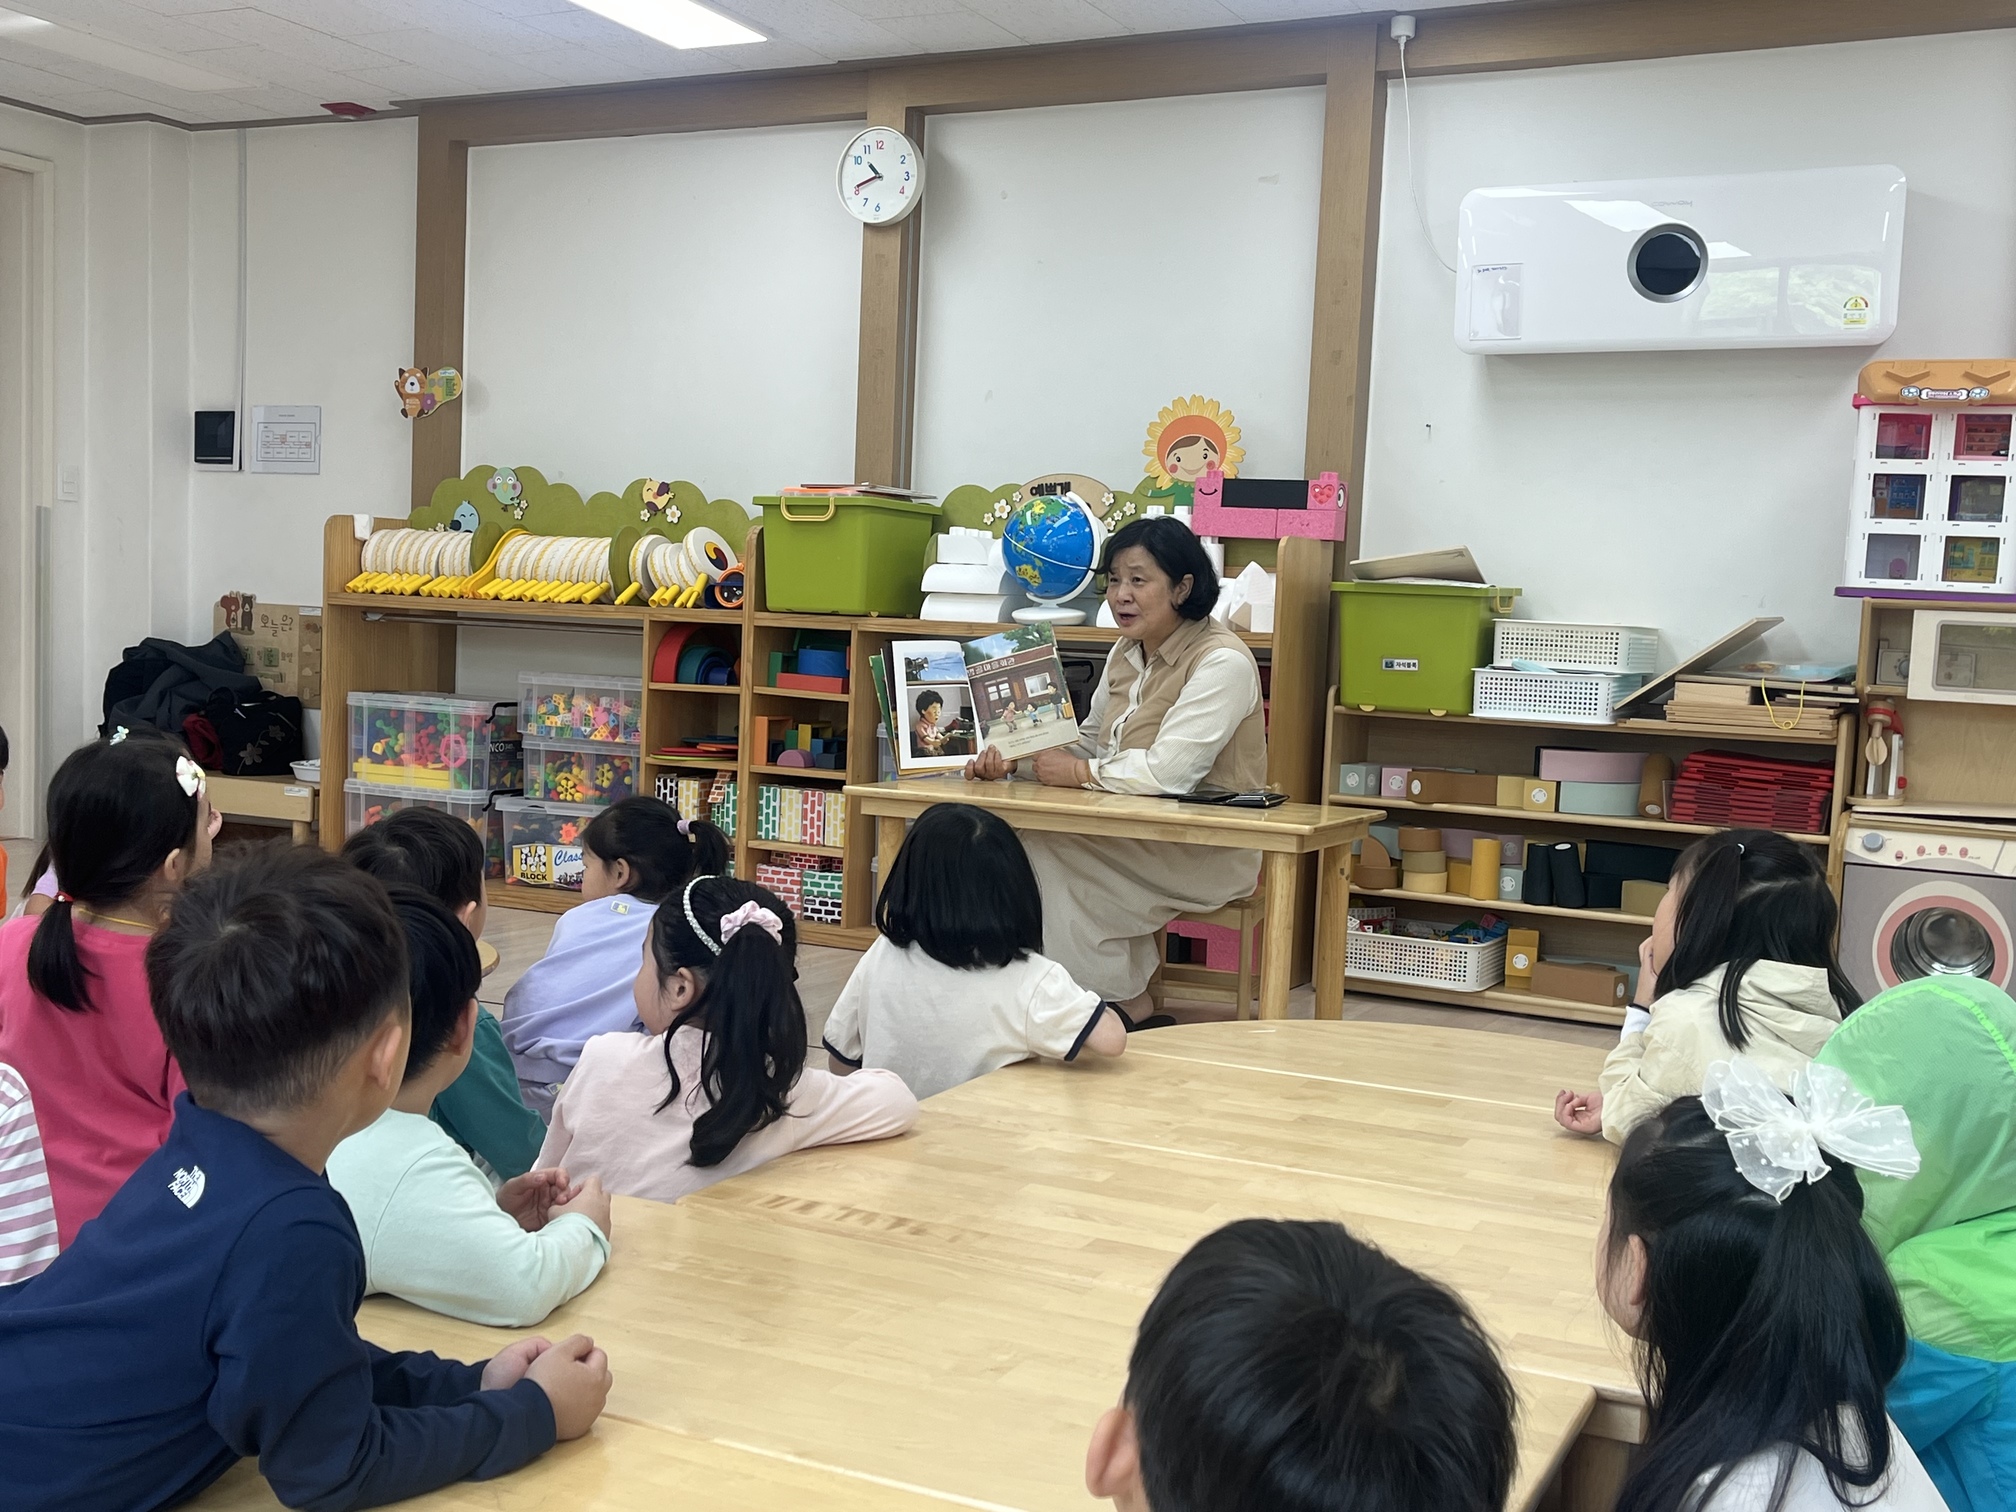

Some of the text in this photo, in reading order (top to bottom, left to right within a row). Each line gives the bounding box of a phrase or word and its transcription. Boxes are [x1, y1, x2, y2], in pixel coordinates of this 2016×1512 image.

[863, 145, 871, 154] 11
[876, 140, 884, 150] 12
[854, 156, 862, 165] 10
[900, 155, 906, 164] 2
[904, 171, 910, 181] 3
[854, 187, 860, 195] 8
[899, 186, 905, 194] 4
[863, 198, 868, 206] 7
[875, 203, 880, 212] 6
[260, 613, 294, 637] 오늘은?
[520, 872, 548, 882] BLOCK
